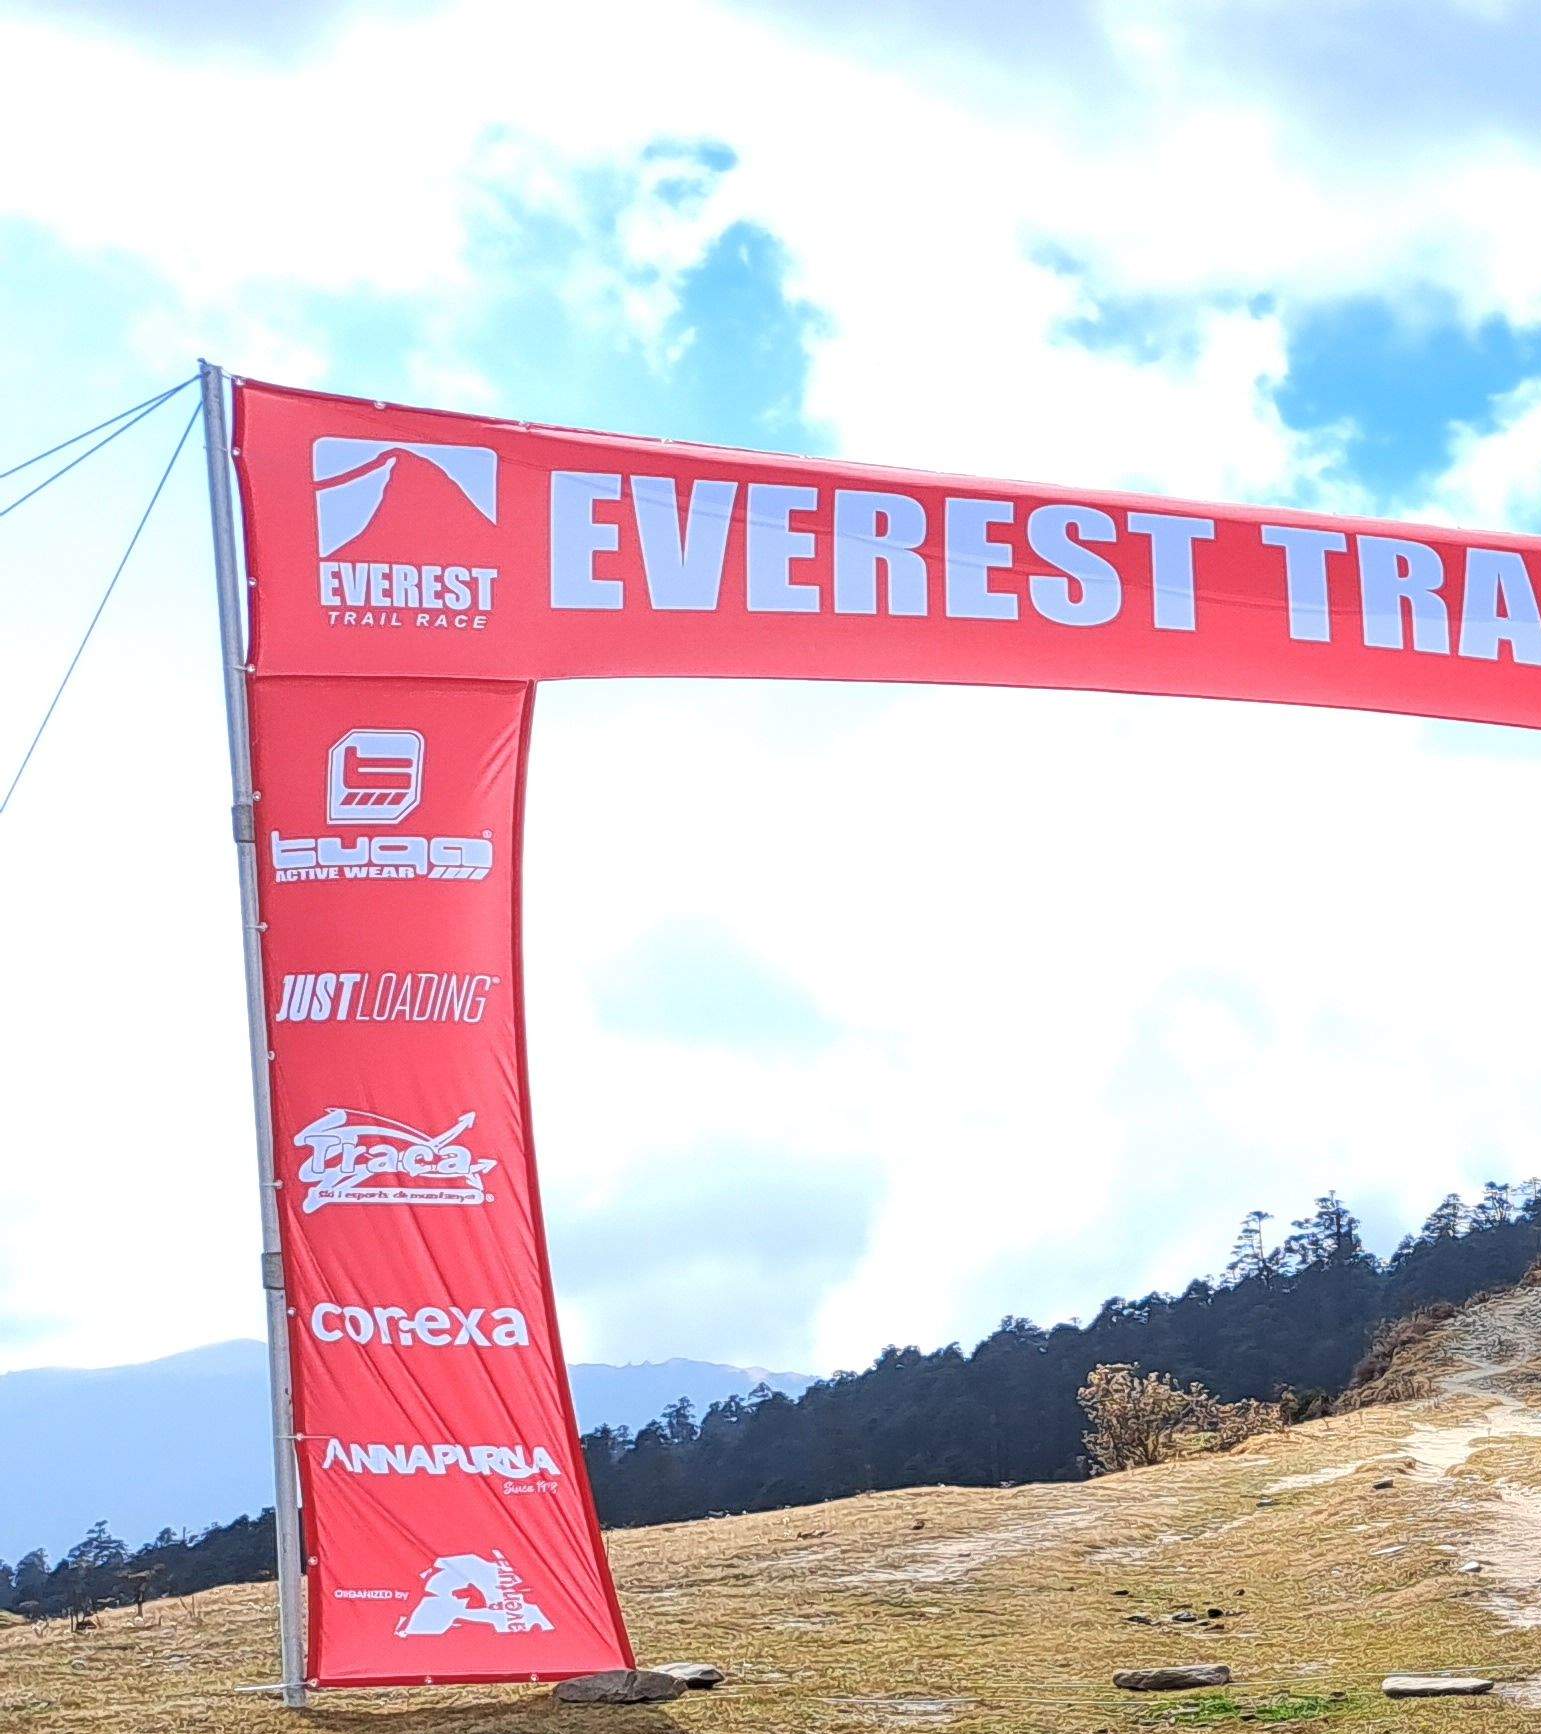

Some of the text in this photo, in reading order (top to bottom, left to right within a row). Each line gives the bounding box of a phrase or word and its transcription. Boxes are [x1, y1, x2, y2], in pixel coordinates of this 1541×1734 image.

[550, 470, 1215, 632] EVEREST
[319, 562, 498, 612] EVEREST
[327, 610, 487, 630] TRAIL RACE
[275, 865, 416, 883] ACTIVE WEAR
[322, 1438, 562, 1479] ANNAPURNA
